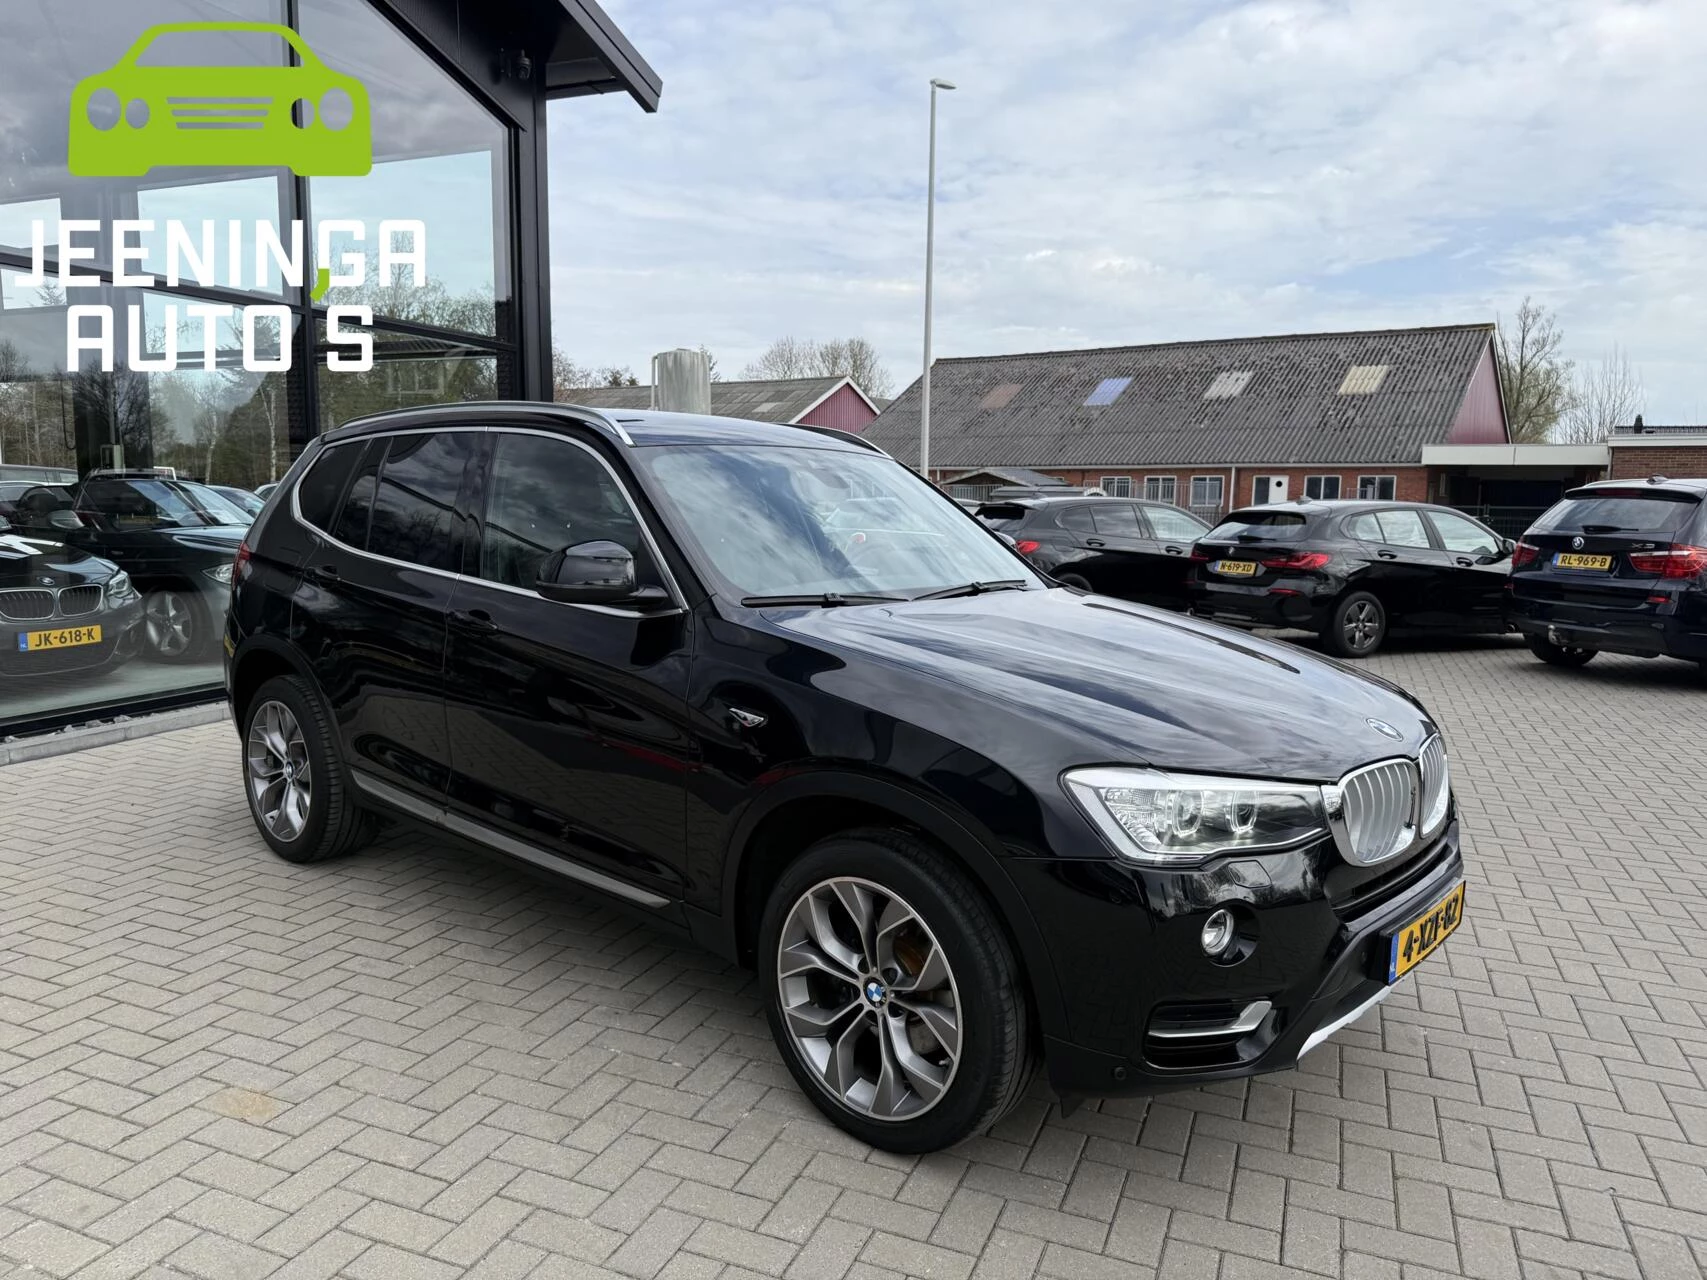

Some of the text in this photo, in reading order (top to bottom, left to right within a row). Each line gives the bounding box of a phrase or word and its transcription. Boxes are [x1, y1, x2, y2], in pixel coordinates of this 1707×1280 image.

[1220, 561, 1252, 572] N-619-XD
[1560, 555, 1608, 568] RL-969-B
[35, 628, 95, 647] JK-618-K
